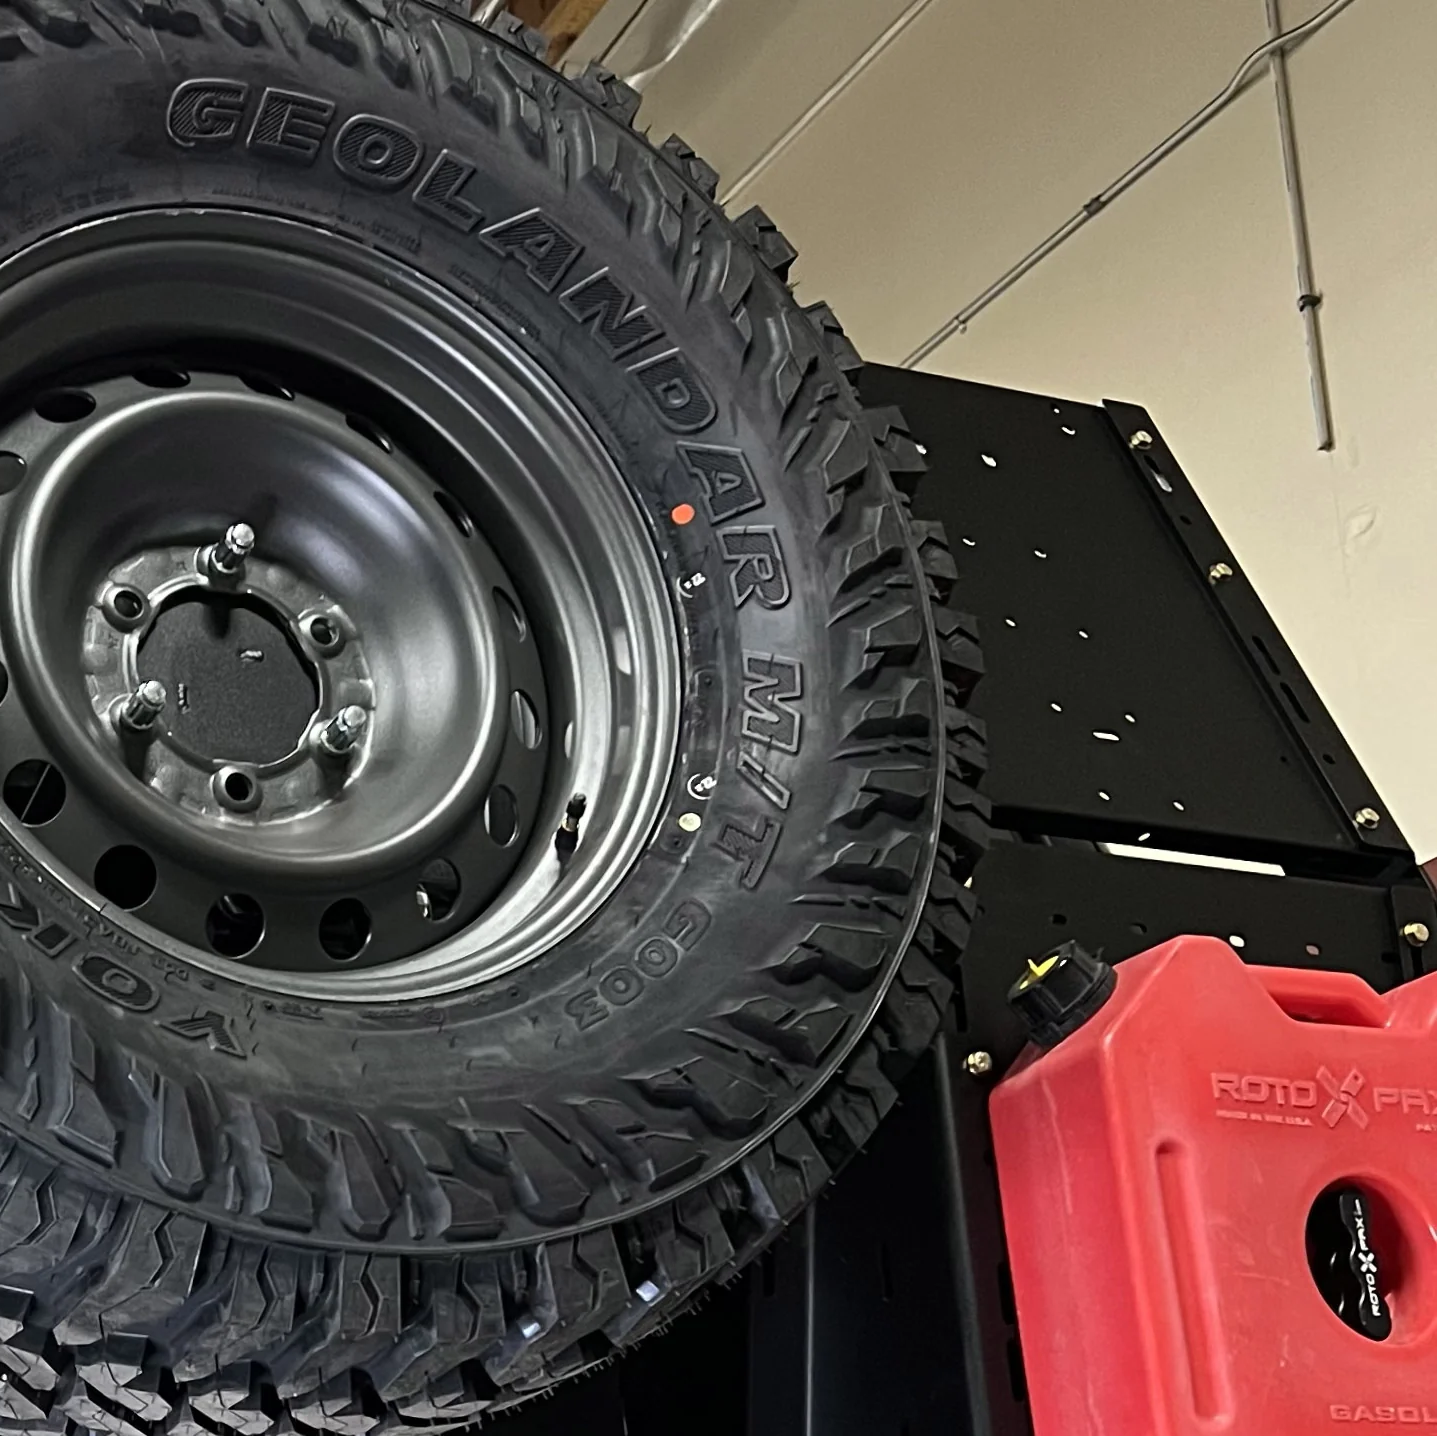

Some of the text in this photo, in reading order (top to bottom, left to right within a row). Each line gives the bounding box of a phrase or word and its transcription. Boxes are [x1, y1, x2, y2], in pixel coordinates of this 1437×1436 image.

[167, 78, 791, 610] GEOLANDAR
[717, 650, 803, 889] M/T
[565, 898, 713, 1032] G003
[1211, 1073, 1437, 1115] ROTO PA
[1355, 1217, 1382, 1317] ROTO PAX
